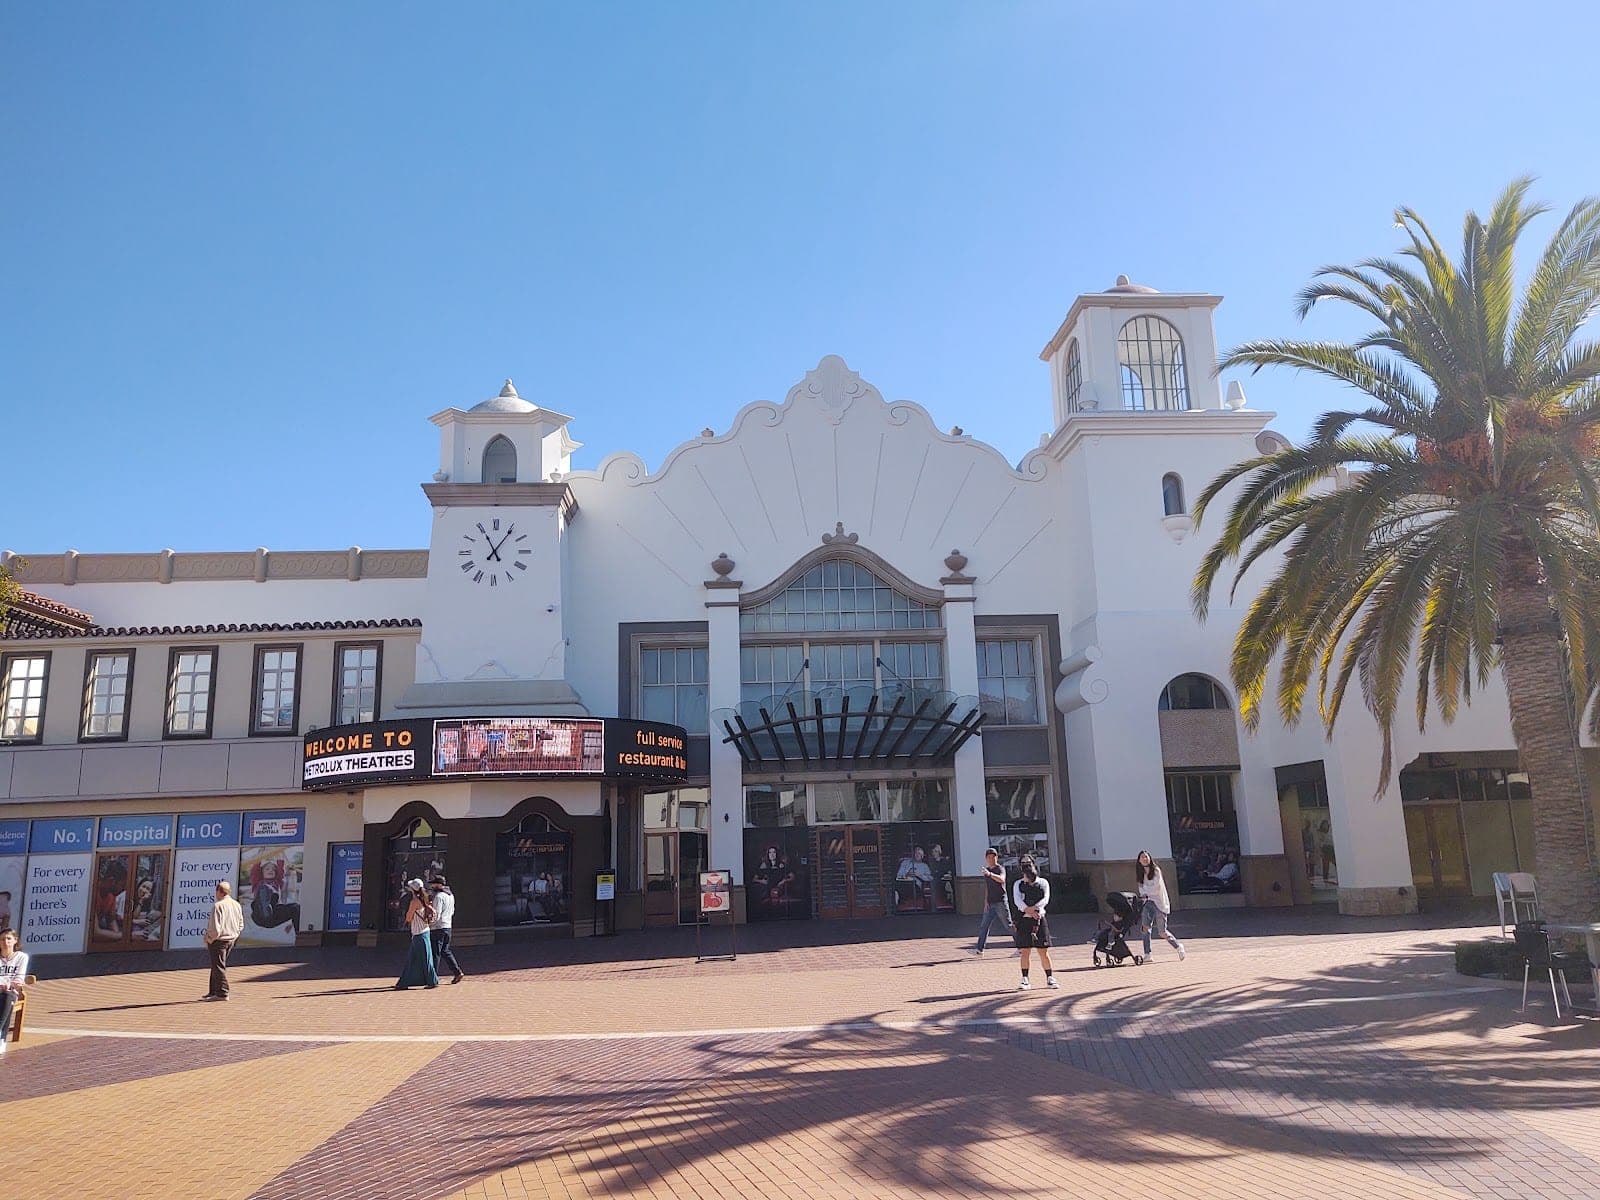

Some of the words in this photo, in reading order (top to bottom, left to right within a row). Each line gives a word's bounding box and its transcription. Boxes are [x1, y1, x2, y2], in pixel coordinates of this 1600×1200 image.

[305, 733, 373, 759] WELCOME
[383, 730, 412, 747] TO
[636, 730, 655, 746] full
[658, 735, 683, 750] service
[345, 754, 414, 771] THEATRES
[619, 752, 674, 768] restaurant
[53, 829, 80, 844] No.
[86, 828, 92, 842] 1
[103, 825, 169, 844] hospital
[182, 824, 196, 839] in
[200, 823, 223, 838] OC
[33, 867, 52, 878] For
[54, 868, 86, 879] every
[180, 861, 199, 872] For
[201, 861, 233, 874] every
[31, 883, 79, 894] moment
[30, 898, 67, 910] there's
[178, 893, 215, 905] there's
[27, 918, 34, 927] a
[37, 915, 81, 926] Mission
[176, 911, 183, 921] a
[186, 909, 212, 921] Miss
[26, 932, 65, 943] doctor.
[175, 926, 208, 937] docto
